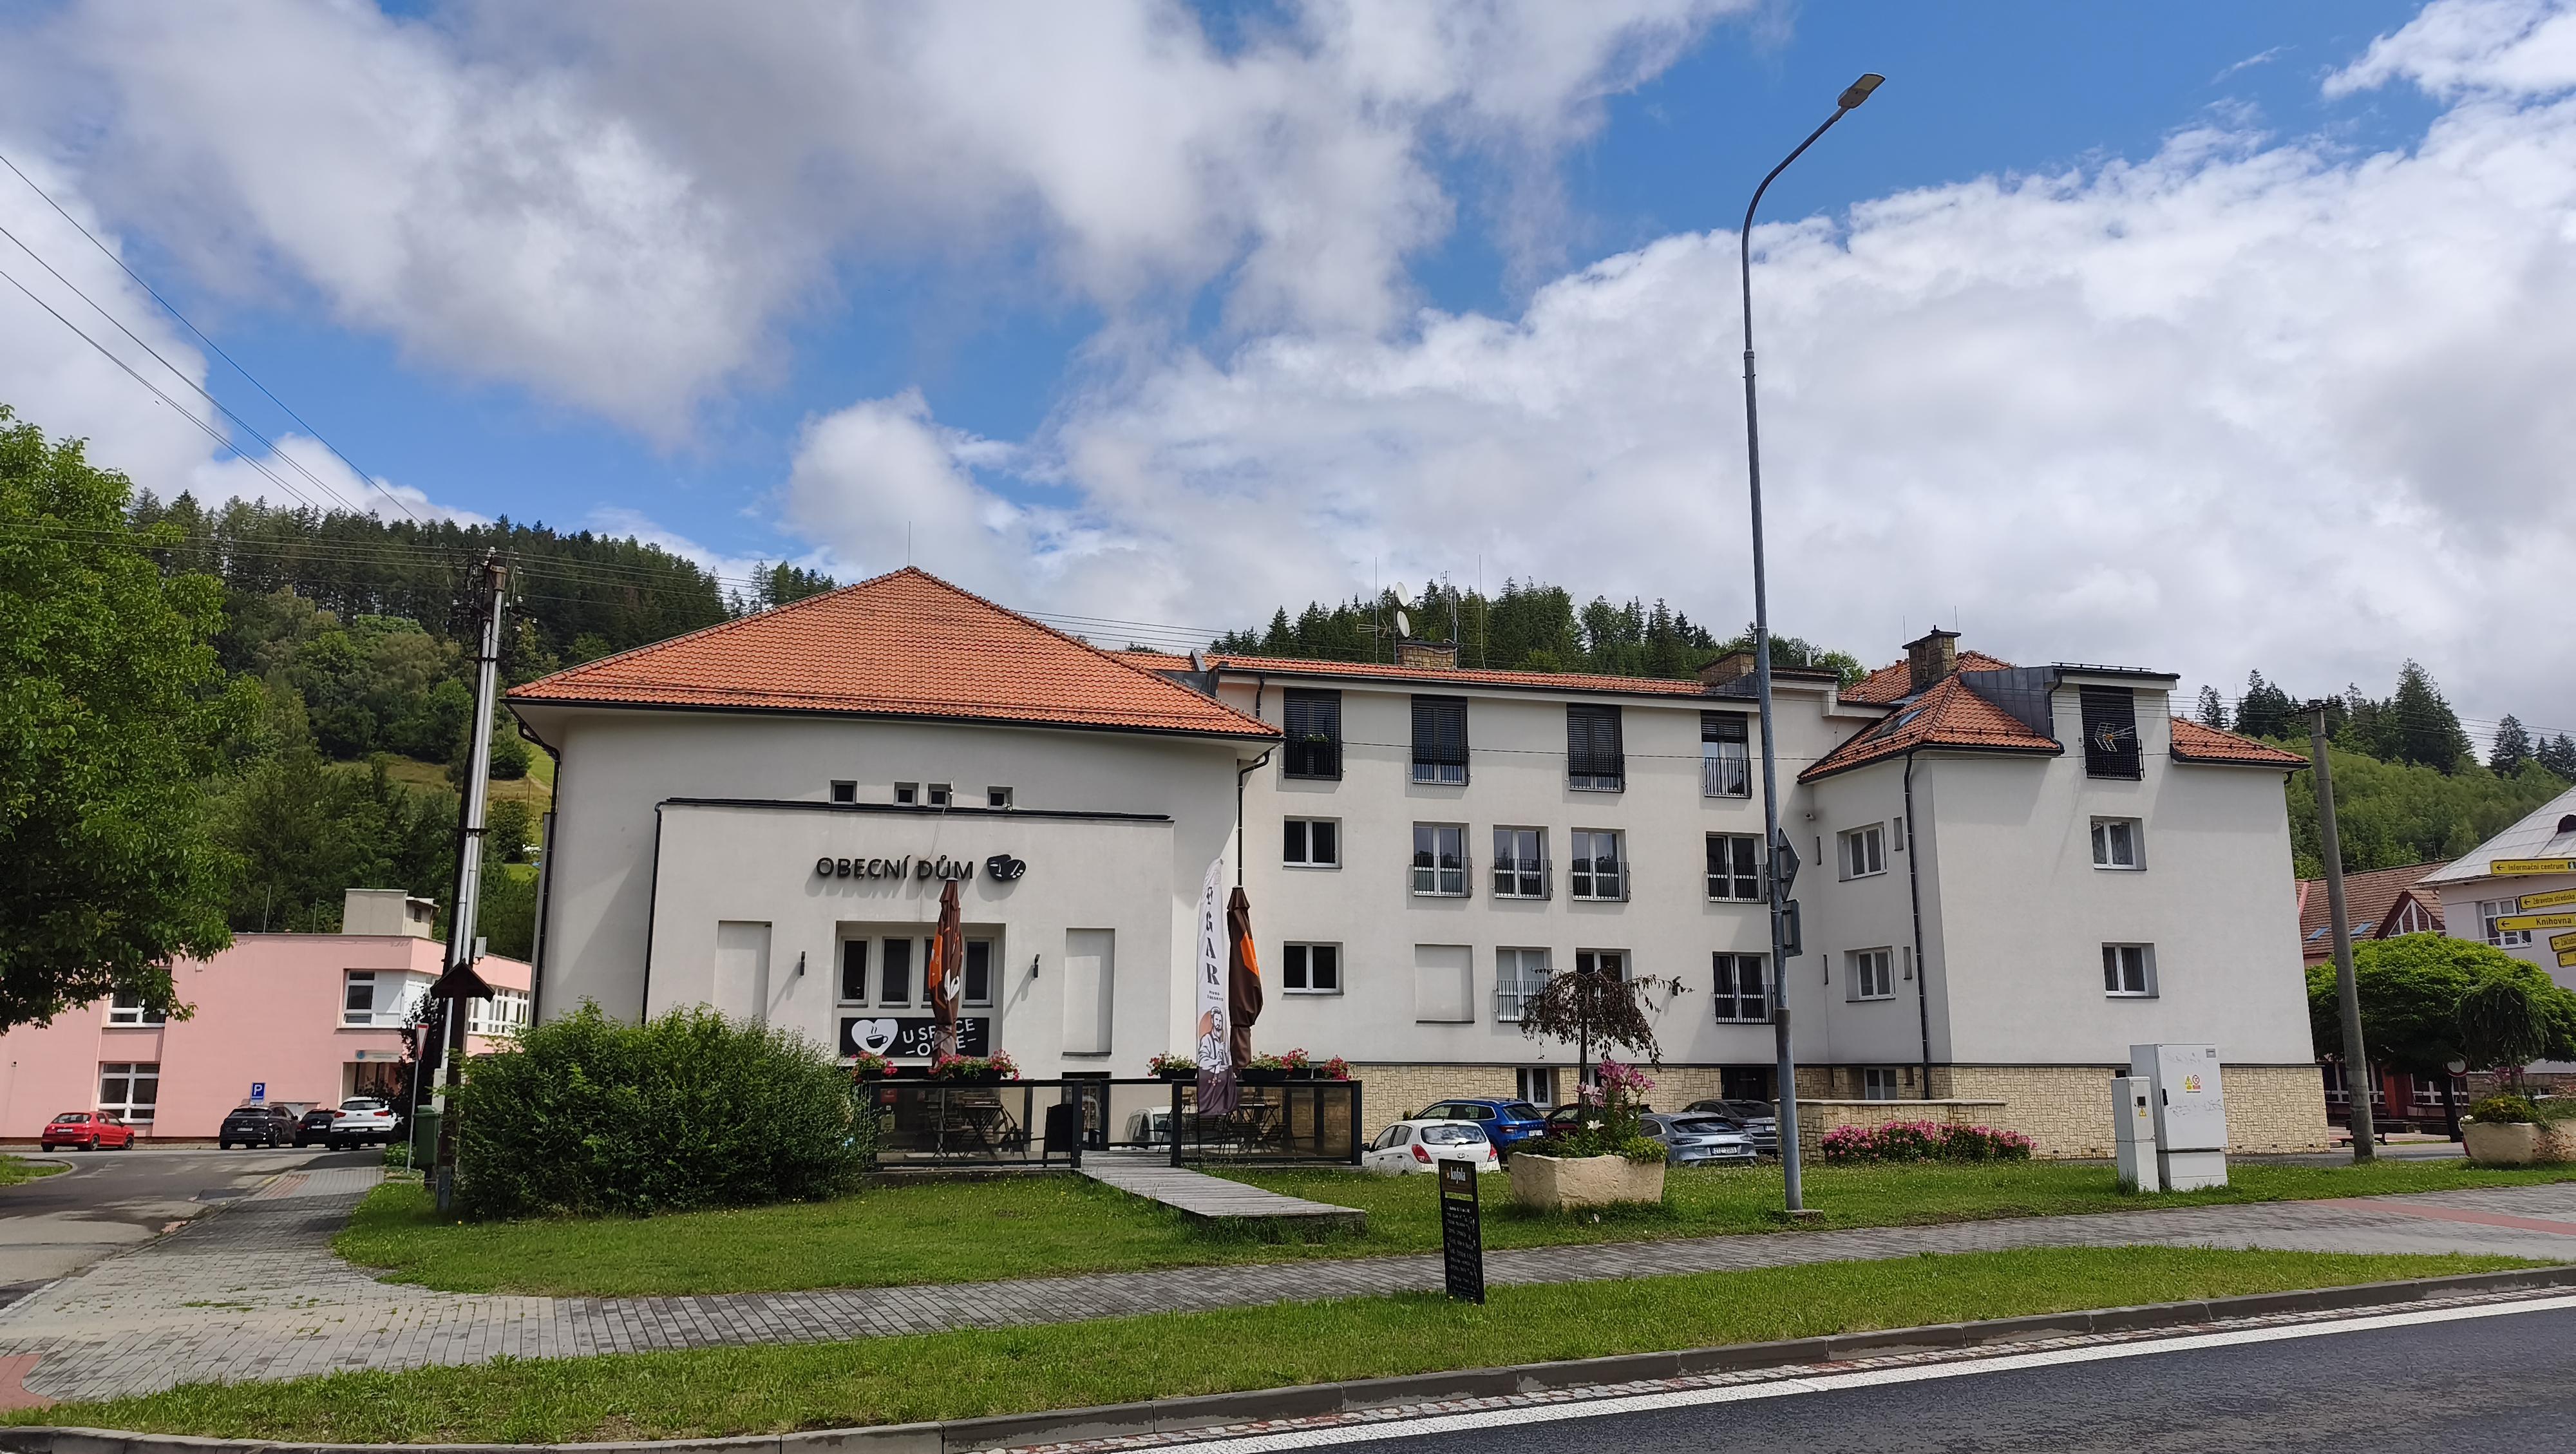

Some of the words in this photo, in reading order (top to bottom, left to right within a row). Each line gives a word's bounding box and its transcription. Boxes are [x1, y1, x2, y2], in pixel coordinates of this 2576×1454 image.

[816, 854, 911, 878] OBECNÍ
[917, 854, 973, 880] DŮM
[2536, 917, 2571, 926] Knihovna
[902, 1029, 914, 1043] U
[254, 1084, 263, 1095] P
